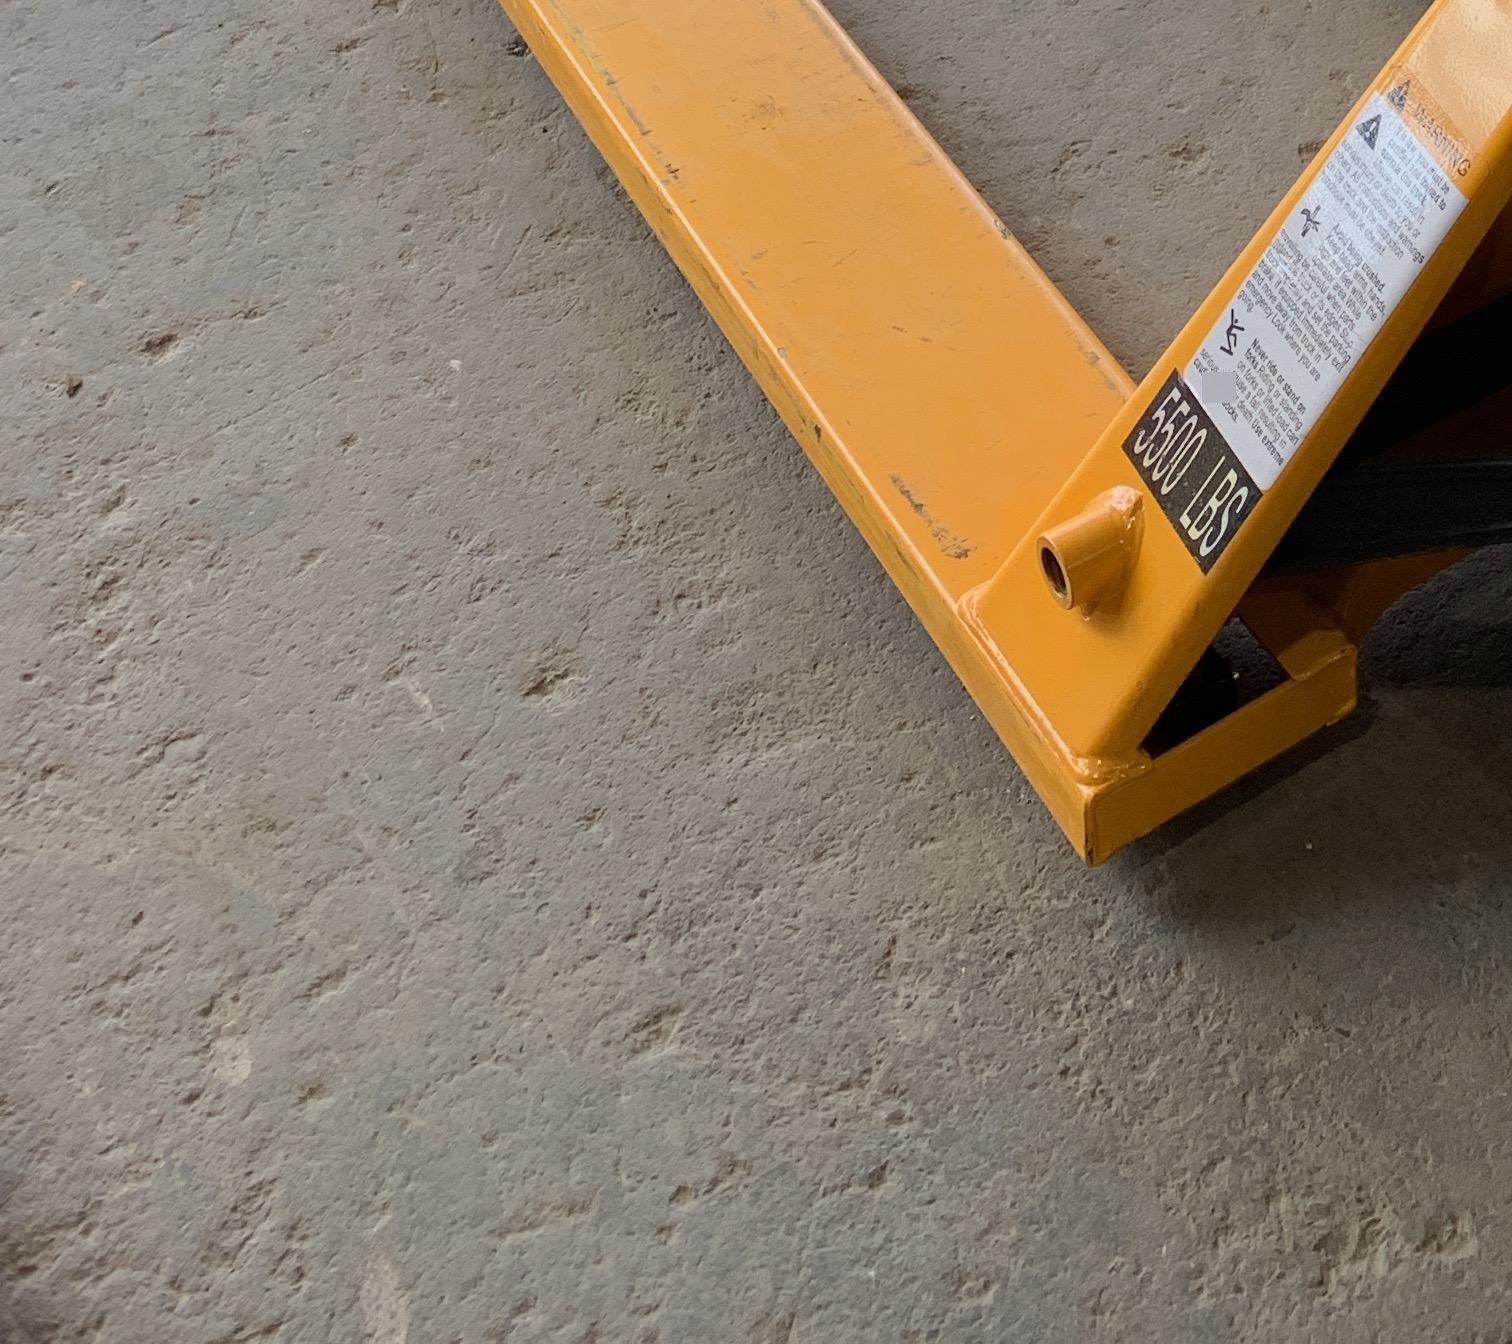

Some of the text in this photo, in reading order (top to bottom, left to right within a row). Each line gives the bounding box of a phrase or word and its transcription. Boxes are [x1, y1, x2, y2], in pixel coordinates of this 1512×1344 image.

[1331, 221, 1351, 247] Avoid
[1344, 241, 1364, 268] being
[1395, 228, 1426, 267] warnings
[1251, 268, 1264, 287] and
[1260, 282, 1277, 305] move
[1273, 301, 1290, 325] away
[1288, 318, 1303, 339] from
[1299, 333, 1316, 356] truck
[1325, 290, 1343, 314] when
[1339, 308, 1357, 332] parts
[1364, 304, 1378, 322] the
[1283, 330, 1302, 356] where
[1297, 352, 1312, 373] you
[1309, 366, 1321, 383] are
[1298, 315, 1333, 362] Immediately
[1330, 355, 1344, 374] exit
[1319, 320, 1332, 338] the
[1327, 333, 1351, 366] parking
[1250, 337, 1269, 363] Never
[1265, 357, 1279, 377] ride
[1281, 380, 1300, 406] stand
[1242, 367, 1260, 392] forks
[1262, 393, 1279, 418] lifted
[1275, 411, 1290, 433] load
[1285, 427, 1299, 447] can
[1248, 394, 1261, 412] fall
[1255, 406, 1281, 443] resulting
[1255, 364, 1276, 394] Riding
[1277, 396, 1304, 433] standing
[1250, 418, 1264, 438] Use
[1261, 433, 1285, 467] extreme
[1134, 386, 1250, 558] 5500 LBS
